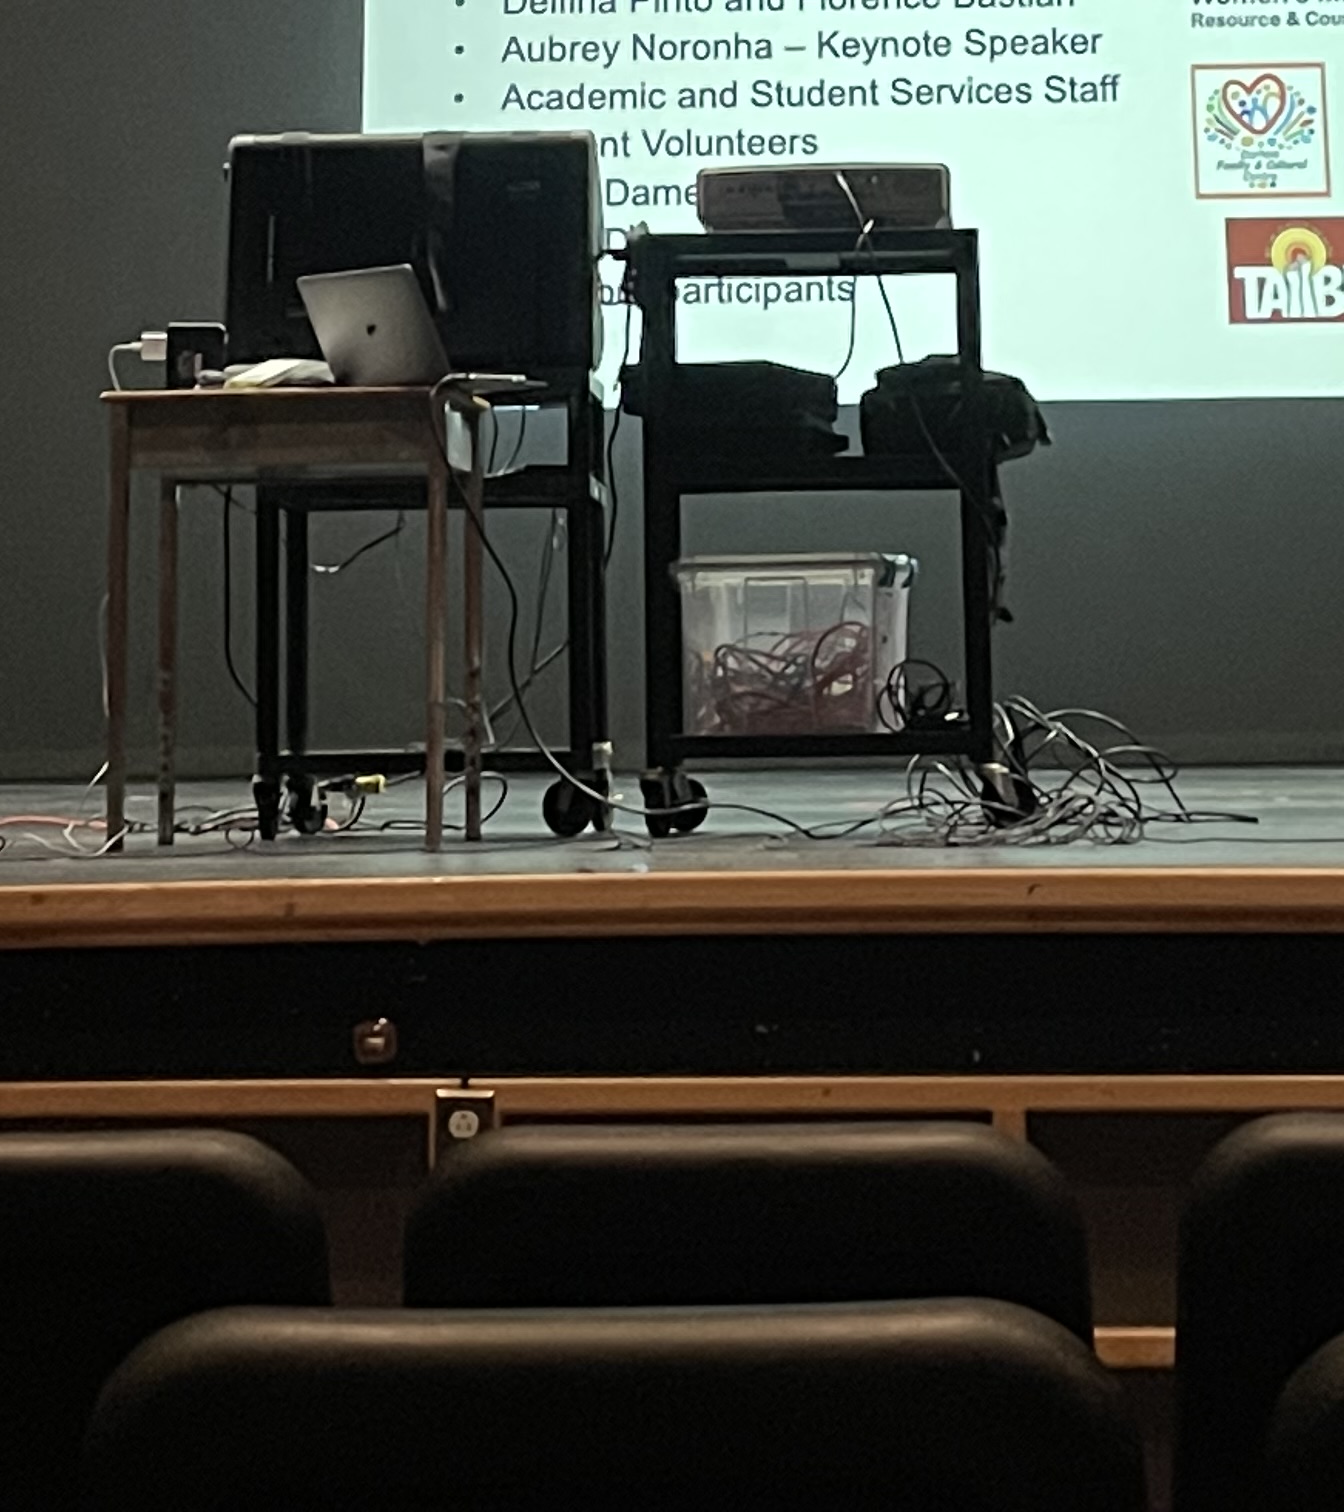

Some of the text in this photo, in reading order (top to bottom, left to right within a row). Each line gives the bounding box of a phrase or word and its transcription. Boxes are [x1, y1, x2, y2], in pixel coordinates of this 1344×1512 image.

[1190, 11, 1281, 29] Resource
[1286, 11, 1300, 27] &
[501, 35, 621, 69] Aubrey
[632, 31, 772, 62] Noronha
[817, 30, 952, 66] Keynote
[964, 27, 1103, 64] Speaker
[501, 73, 1121, 111] Academic and Student Services Staff
[641, 128, 819, 157] Volunteers
[674, 276, 854, 310] articipants
